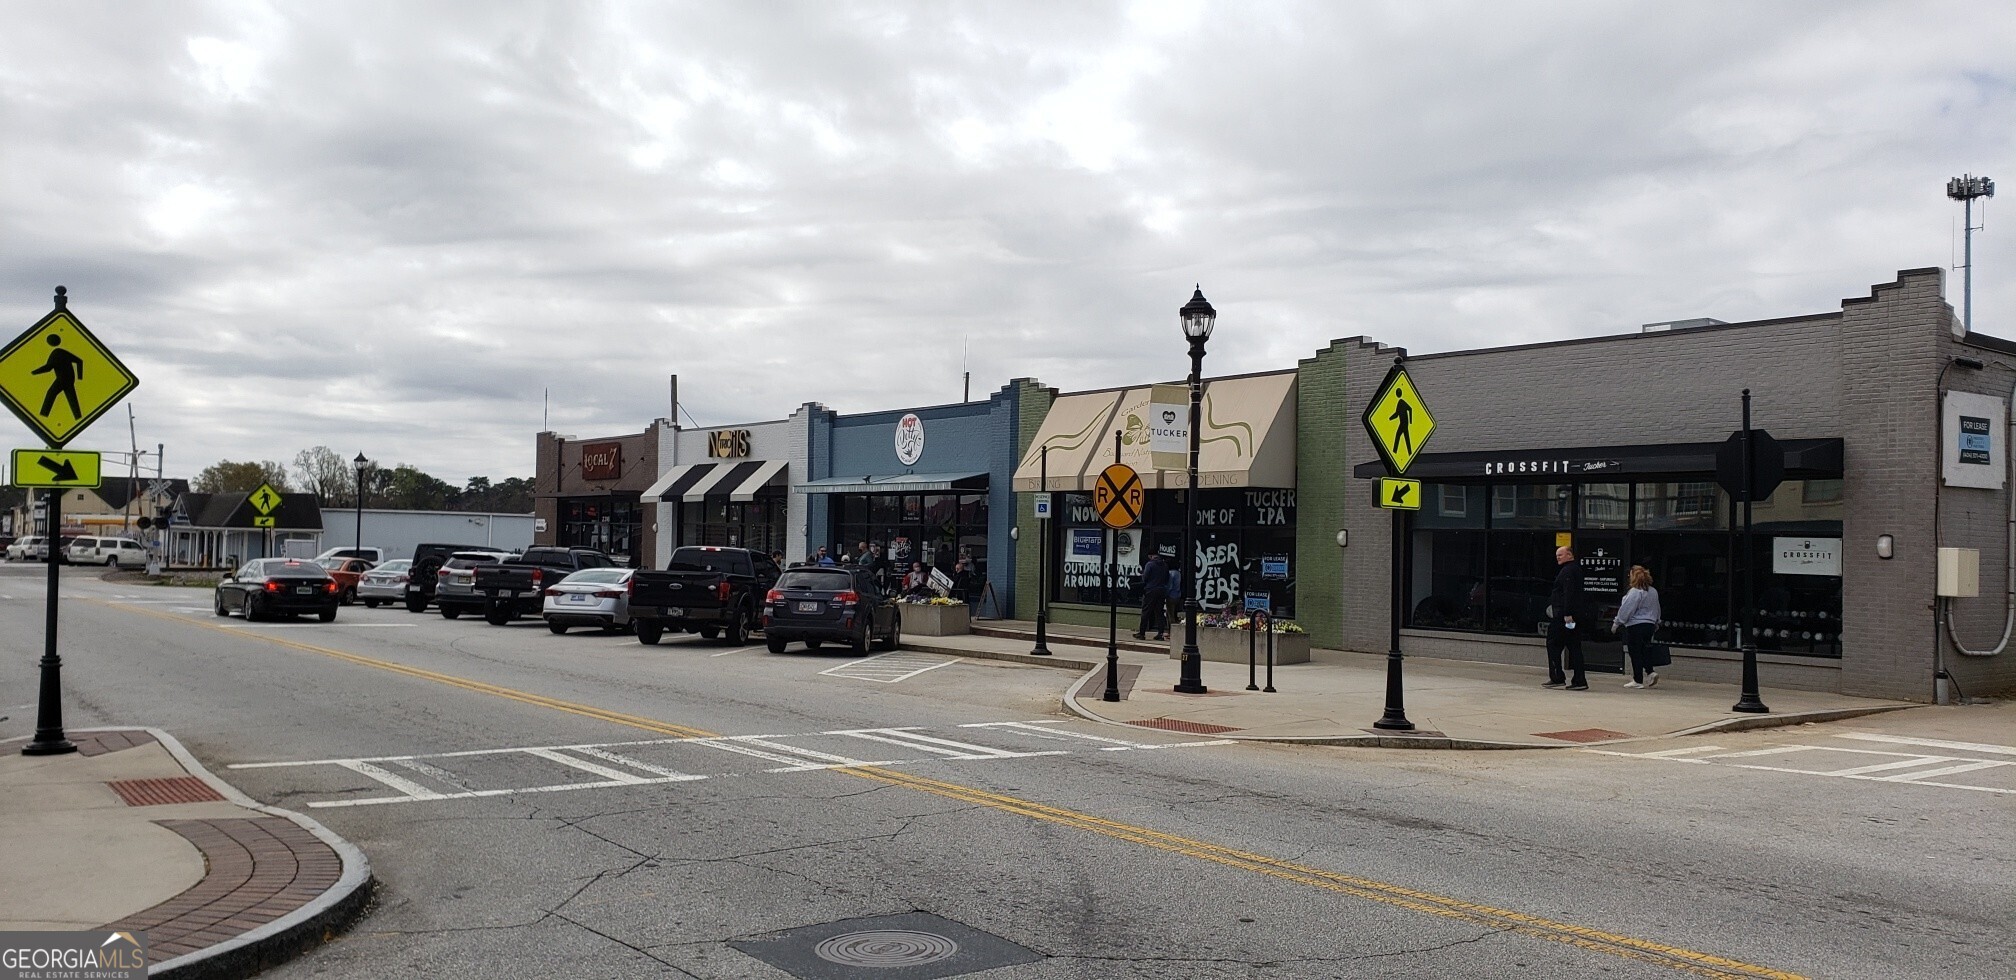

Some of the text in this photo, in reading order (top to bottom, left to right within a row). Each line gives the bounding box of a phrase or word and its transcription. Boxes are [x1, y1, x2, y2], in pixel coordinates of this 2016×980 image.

[902, 417, 917, 428] HOT
[1963, 421, 1988, 431] FOR LEASE
[1150, 428, 1188, 438] TUCKER
[584, 453, 609, 472] LOCAL
[1485, 461, 1608, 476] CROSSFIT Tucker
[1028, 478, 1061, 490] BIRING
[1174, 473, 1238, 487] GADENING
[1097, 486, 1141, 506] R R
[1244, 490, 1296, 508] TUCKER
[1196, 508, 1236, 526] OME OF
[1256, 506, 1286, 525] IPA
[1158, 543, 1177, 555] HOURS
[1783, 551, 1832, 560] CROSSFIT
[1117, 563, 1143, 577] ATIO
[1580, 559, 1621, 567] CROSSFIT
[1207, 566, 1222, 580] IN
[1063, 575, 1132, 590] AROUND BCK
